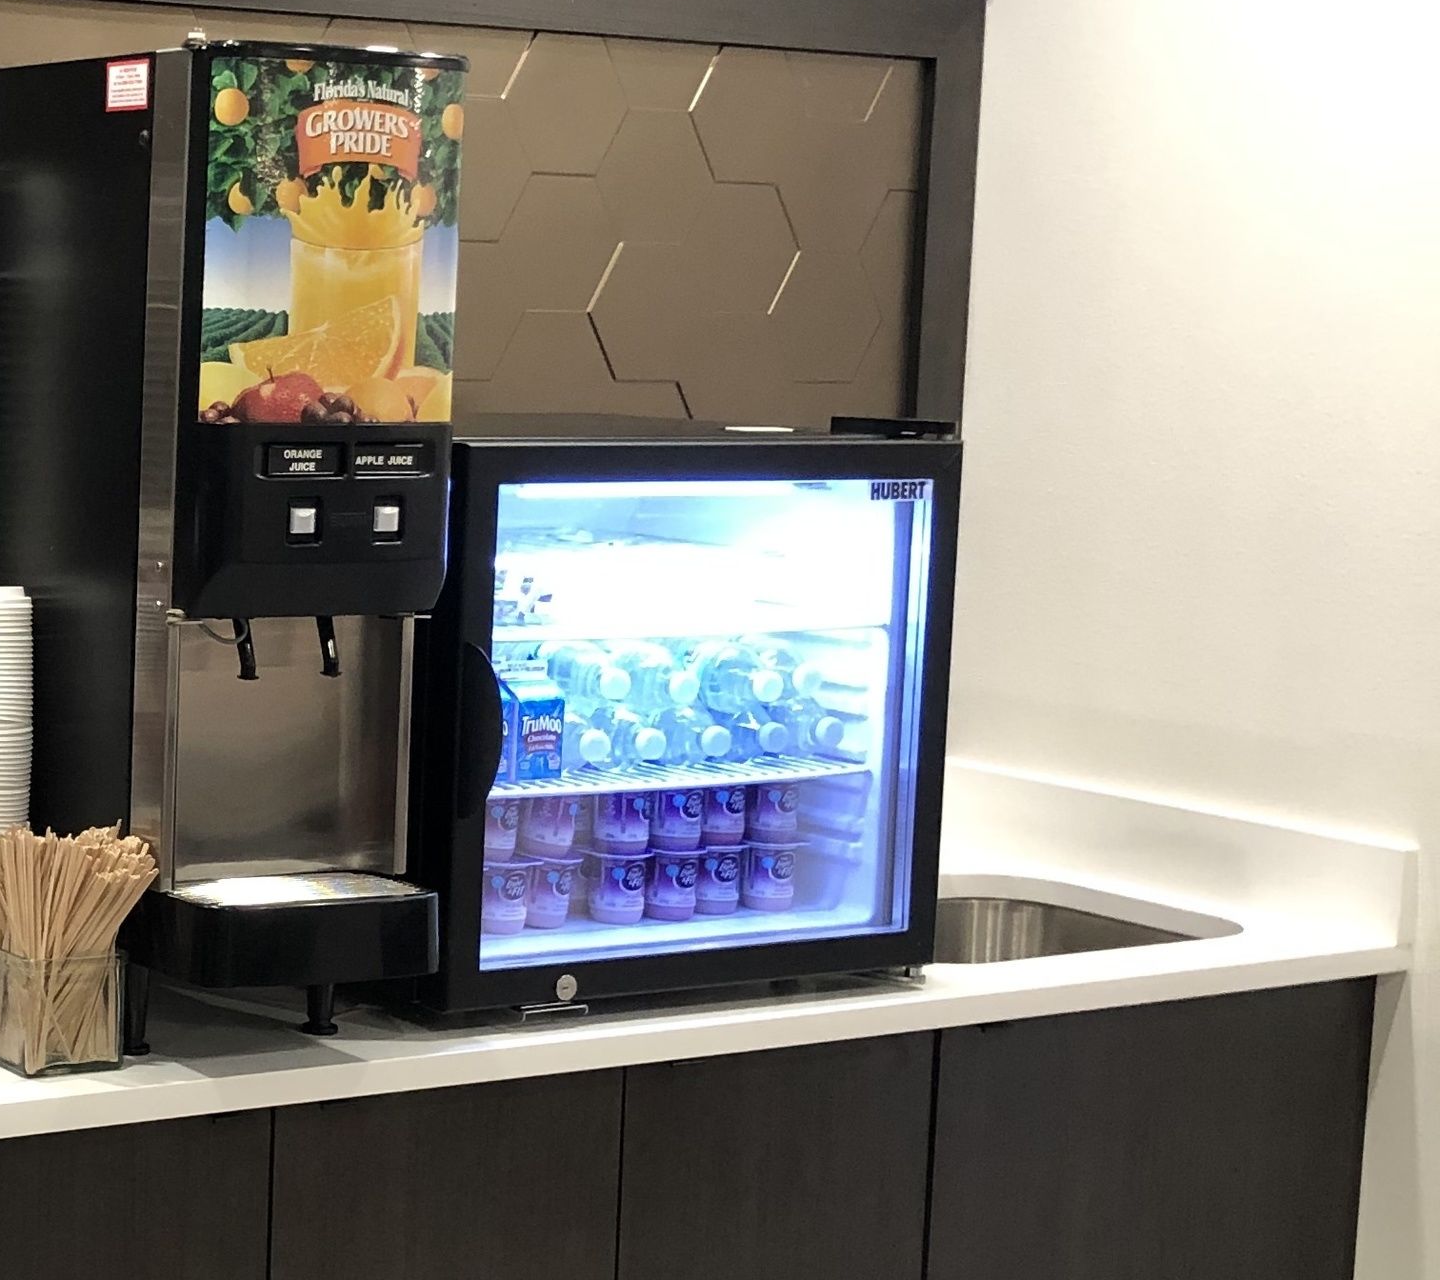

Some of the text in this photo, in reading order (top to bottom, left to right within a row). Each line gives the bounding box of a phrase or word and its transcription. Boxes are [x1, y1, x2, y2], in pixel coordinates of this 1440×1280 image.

[313, 77, 410, 108] Florida's Natural
[305, 108, 409, 138] GROWERS
[330, 131, 392, 157] PRIDE
[283, 449, 323, 459] ORANGE
[355, 455, 414, 466] APPLE JUICE
[289, 462, 316, 471] JUICE
[870, 481, 927, 501] HUBERT
[522, 715, 562, 736] TruMoo
